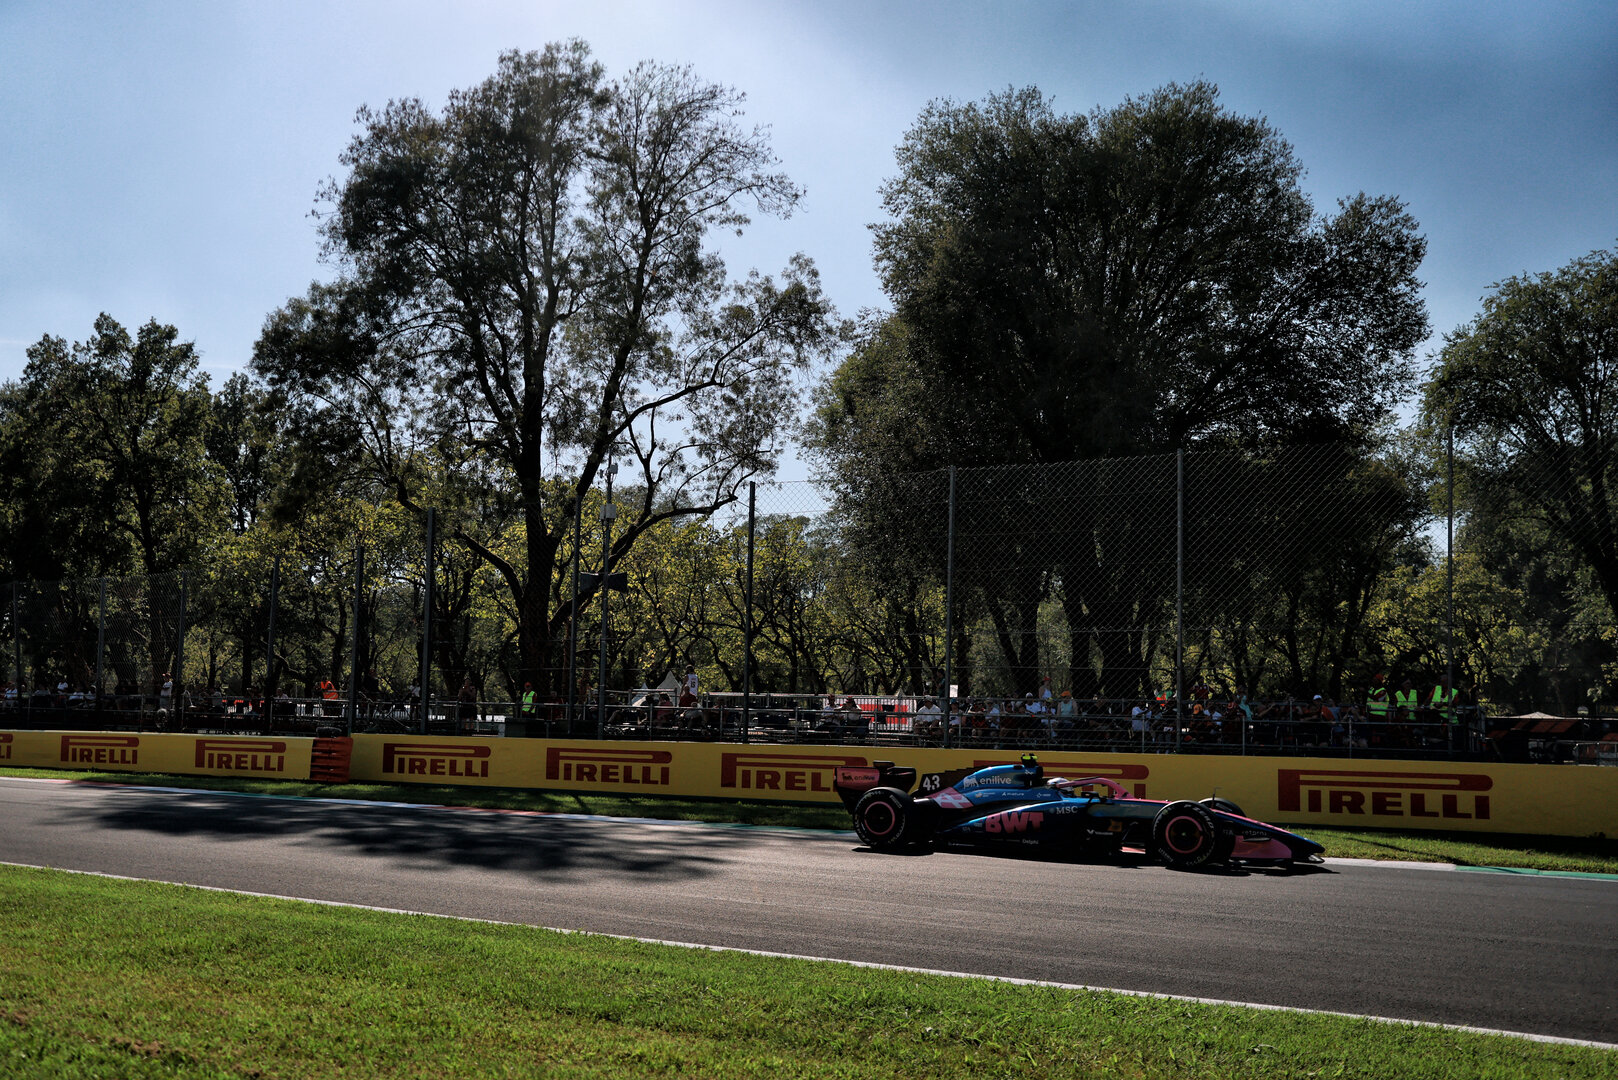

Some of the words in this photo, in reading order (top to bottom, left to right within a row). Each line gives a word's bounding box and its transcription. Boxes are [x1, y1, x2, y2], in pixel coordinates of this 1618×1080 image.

[60, 735, 139, 765] PIRELLI
[195, 739, 286, 772] PIRELLI
[382, 743, 491, 778] PIRELLI
[546, 747, 672, 785] PIRELLI
[721, 753, 867, 792] PIREL
[979, 775, 1012, 785] enilive
[923, 775, 940, 791] 43
[1278, 769, 1493, 819] PIRELLI
[985, 812, 1045, 834] BWT
[1056, 806, 1079, 815] MSC
